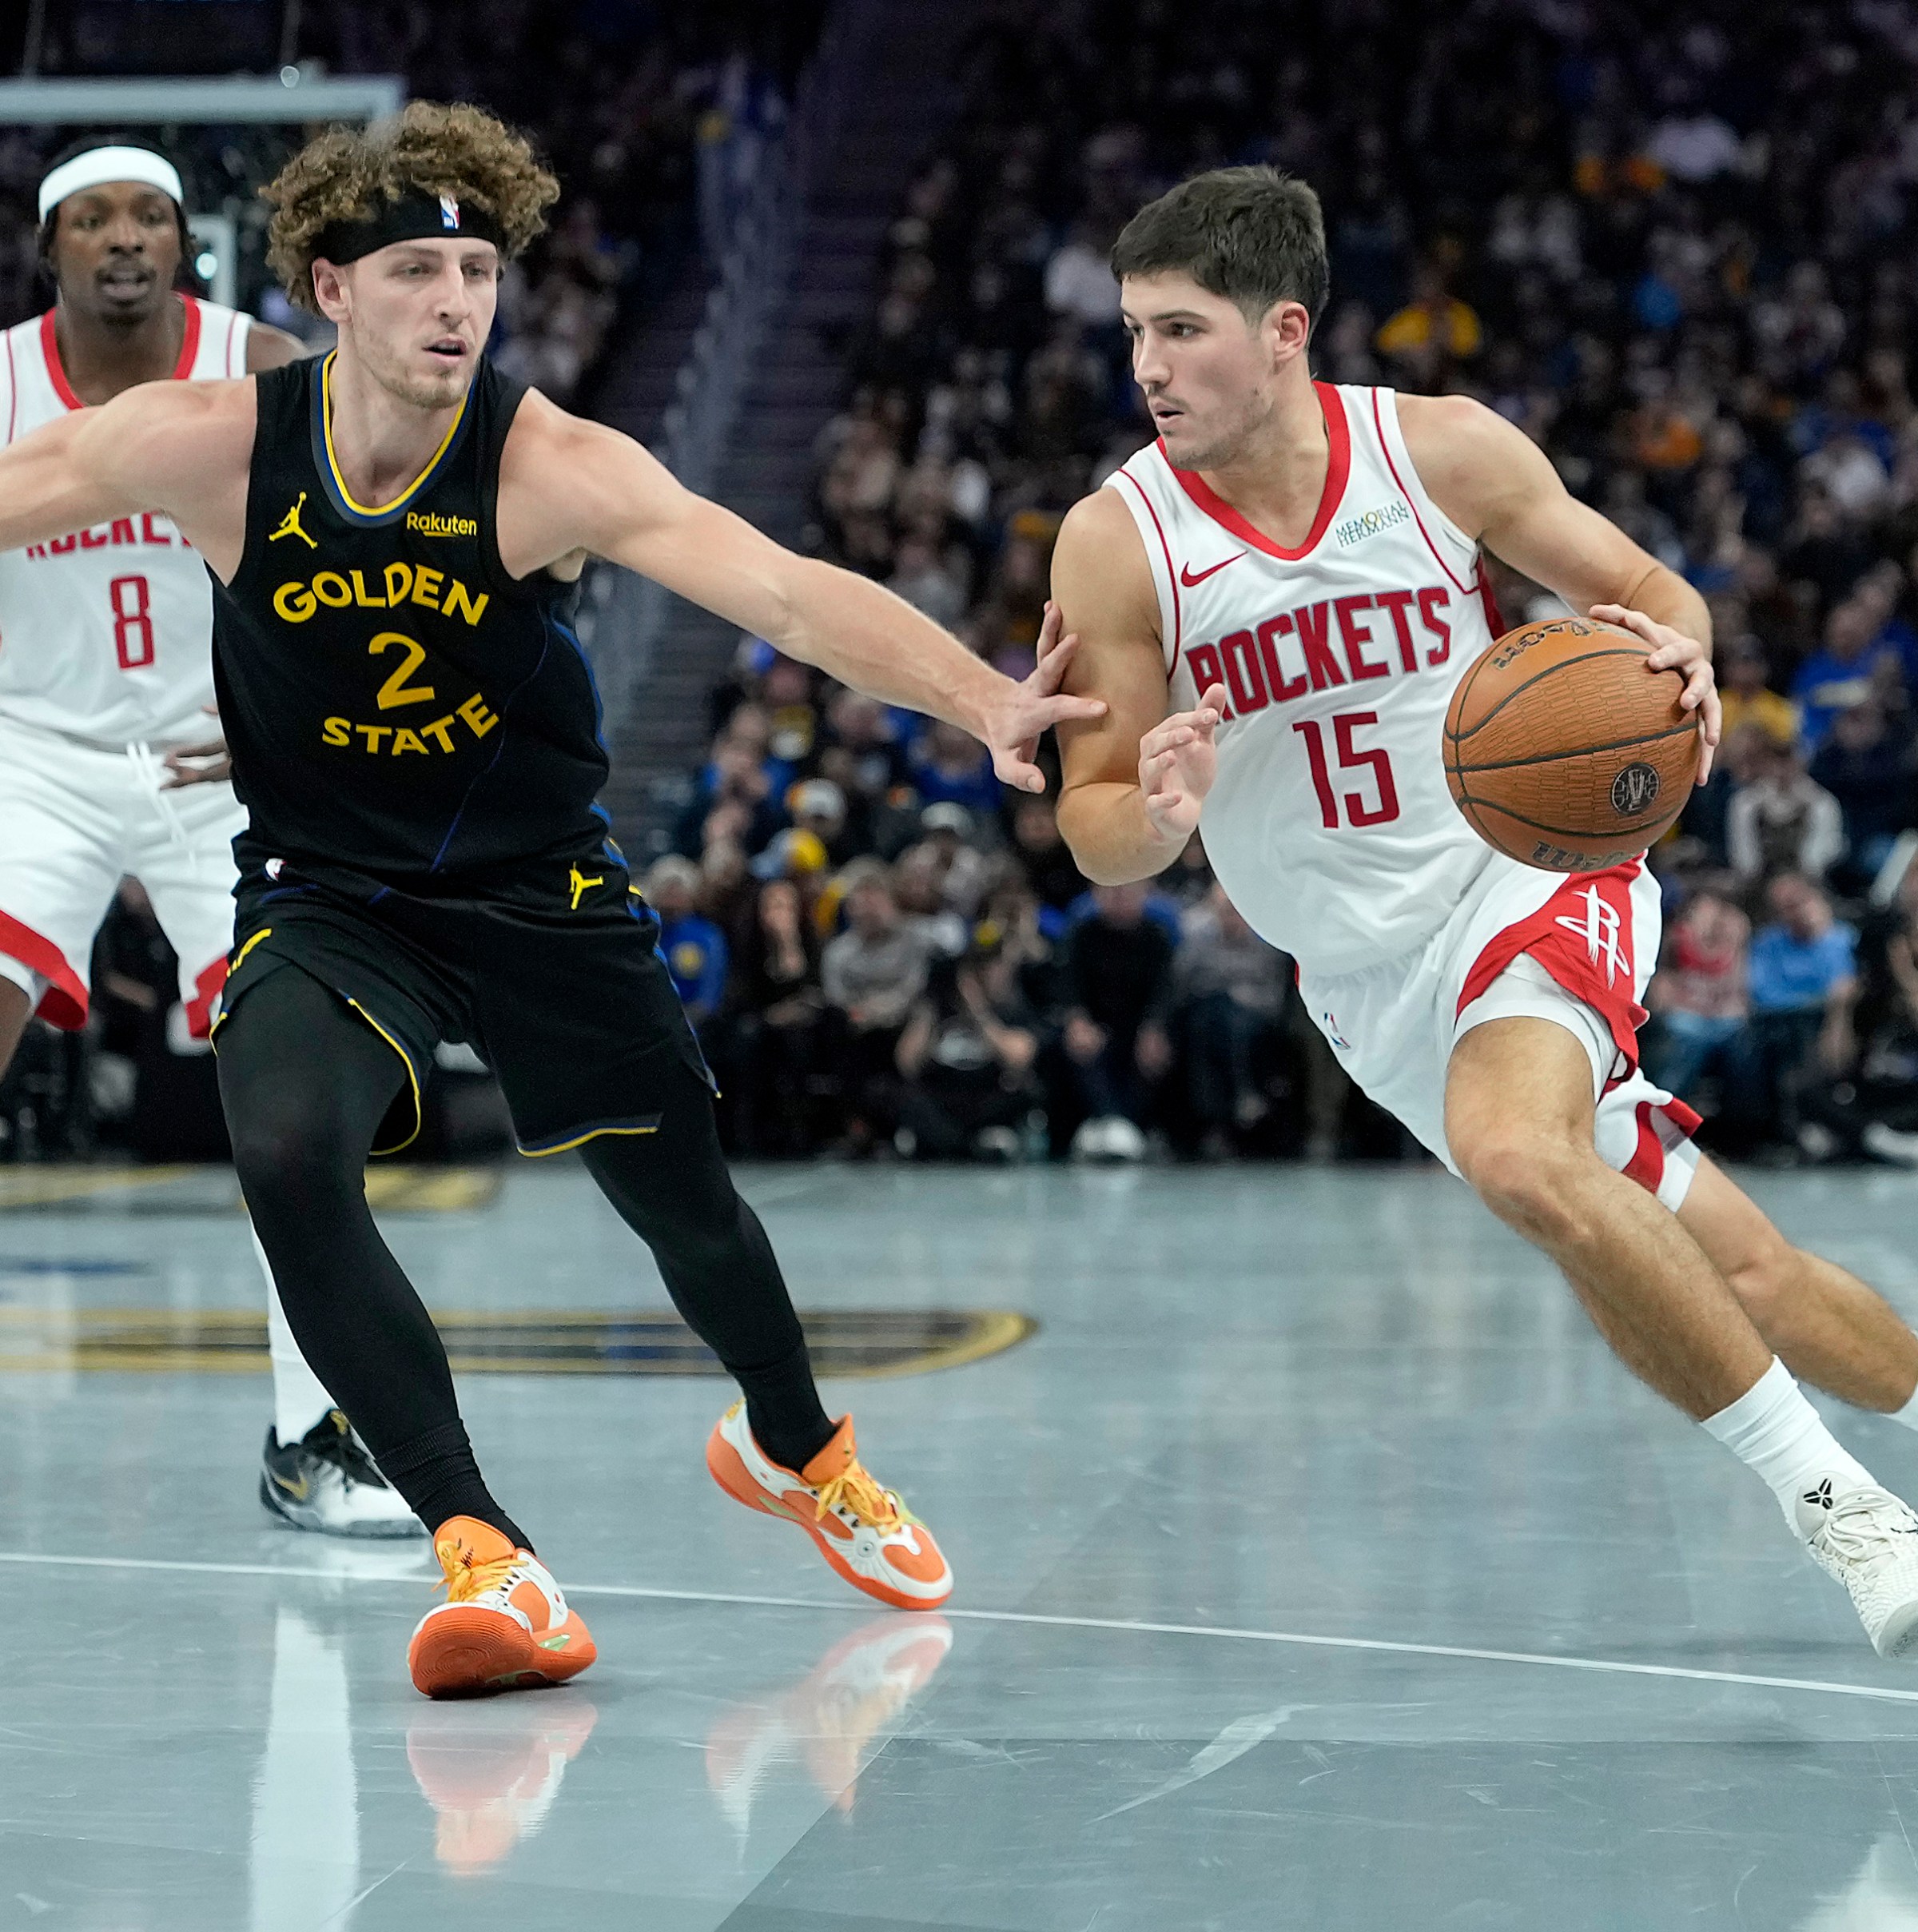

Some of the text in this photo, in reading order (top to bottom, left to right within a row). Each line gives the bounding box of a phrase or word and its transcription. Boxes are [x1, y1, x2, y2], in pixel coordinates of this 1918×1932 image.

[406, 512, 477, 537] Rakuten
[1335, 500, 1408, 536] MEMORIAL
[1336, 507, 1410, 548] HERMANN
[109, 575, 155, 669] 8
[273, 561, 489, 627] GOLDEN
[368, 631, 435, 711] 2
[1184, 586, 1451, 723] ROCKETS
[322, 692, 499, 755] STATE
[1292, 711, 1400, 830] 15
